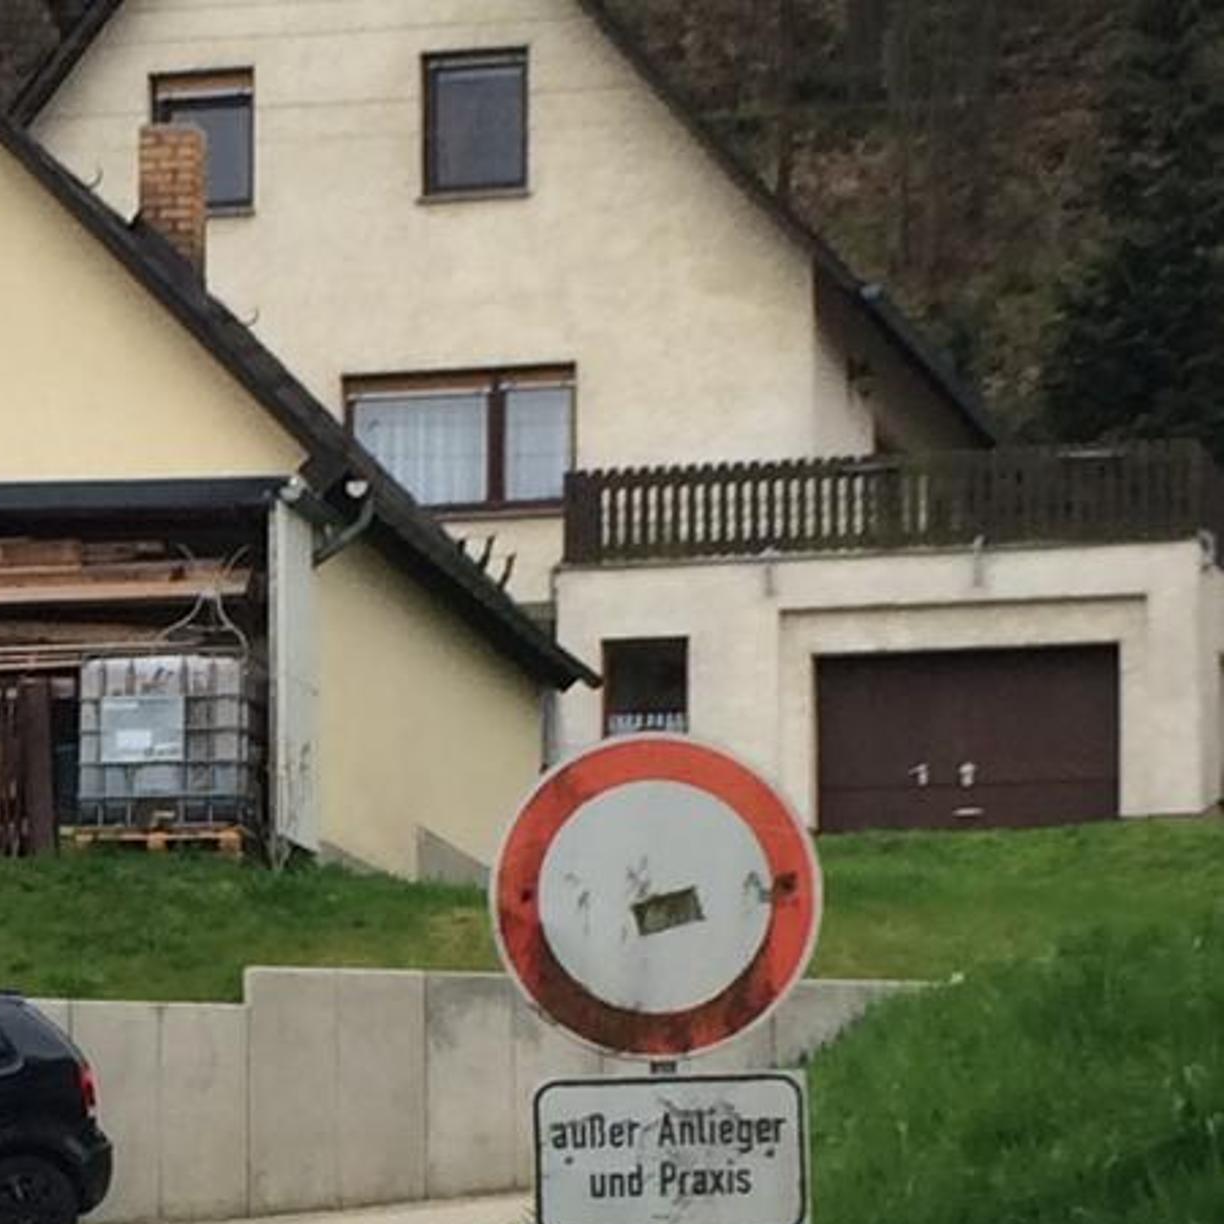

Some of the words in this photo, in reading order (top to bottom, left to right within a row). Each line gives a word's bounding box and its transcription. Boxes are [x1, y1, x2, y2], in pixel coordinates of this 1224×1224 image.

[551, 1113, 640, 1150] außer
[658, 1109, 786, 1153] Anlieger
[589, 1165, 643, 1198] und
[660, 1162, 752, 1197] Praxis
